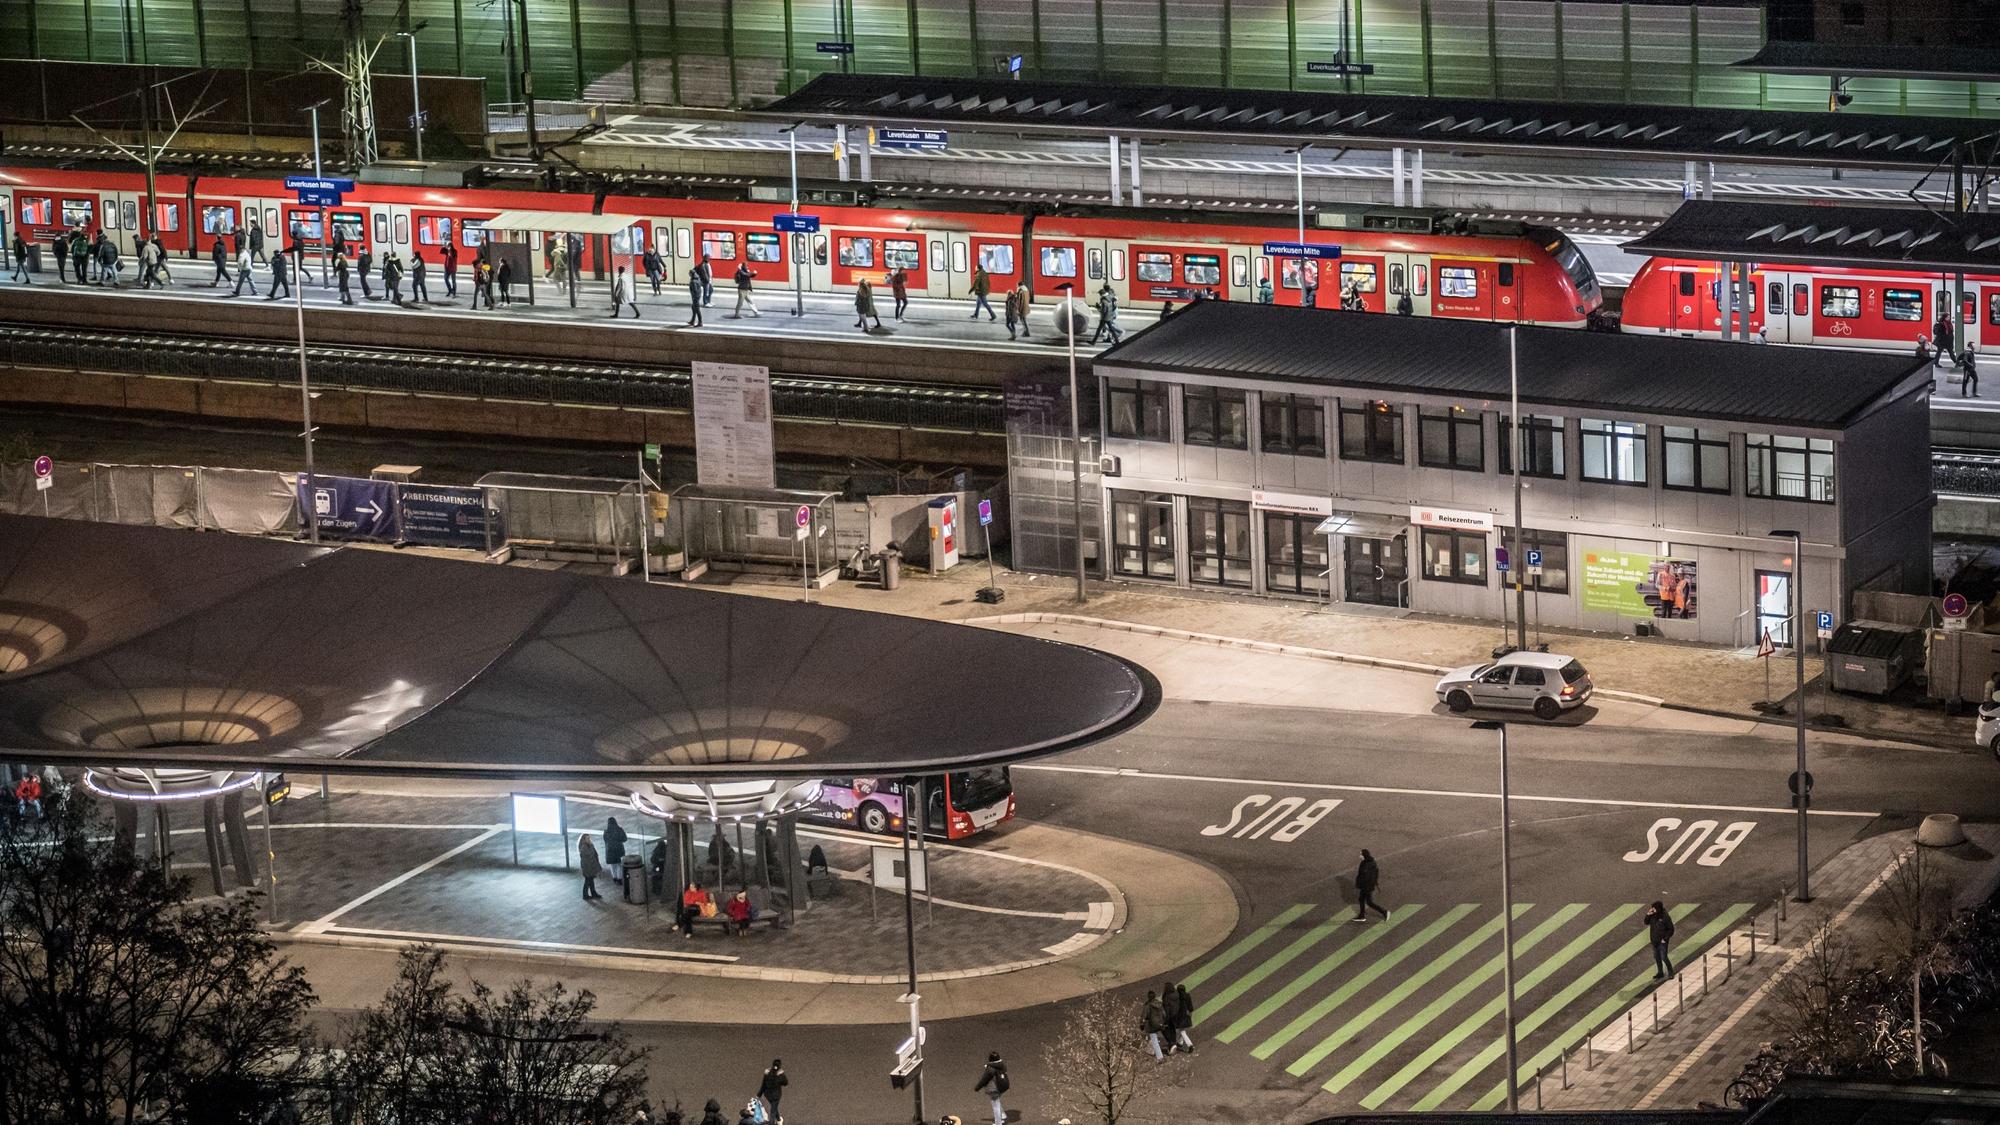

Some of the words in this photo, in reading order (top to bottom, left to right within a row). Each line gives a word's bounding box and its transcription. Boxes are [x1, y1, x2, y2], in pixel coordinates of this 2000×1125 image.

[887, 131, 920, 139] Leverkusen
[287, 180, 319, 189] Leverkusen
[453, 218, 460, 228] 2
[738, 232, 744, 242] 2
[875, 239, 882, 249] 2
[1266, 245, 1302, 255] Leverkusen
[1303, 247, 1320, 256] Mitte
[1175, 254, 1182, 264] 2
[1326, 261, 1332, 272] 2
[1868, 288, 1875, 299] 2
[321, 519, 334, 527] den
[1438, 514, 1484, 525] Reisezentrum
[1530, 552, 1539, 564] P
[1820, 614, 1829, 627] P
[984, 812, 997, 821] MAN
[1200, 794, 1344, 842] BUS
[1622, 817, 1758, 867] BUS
